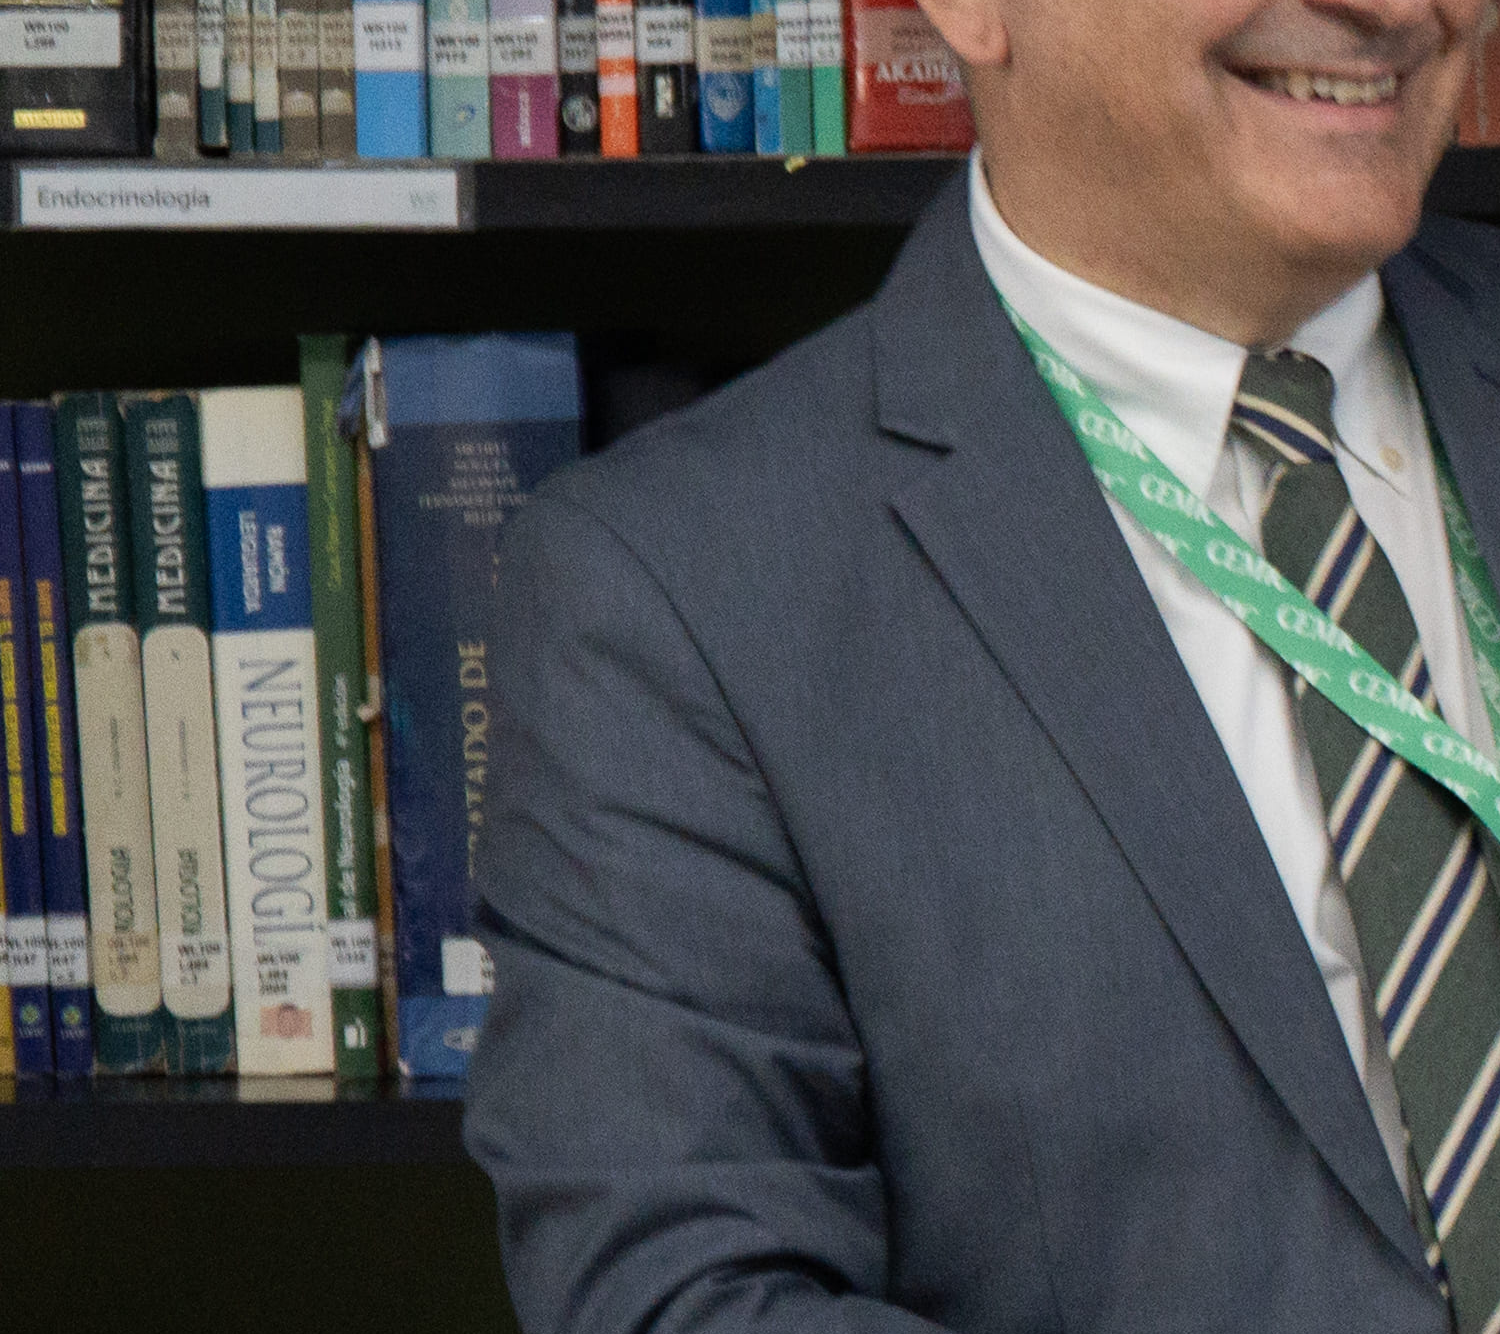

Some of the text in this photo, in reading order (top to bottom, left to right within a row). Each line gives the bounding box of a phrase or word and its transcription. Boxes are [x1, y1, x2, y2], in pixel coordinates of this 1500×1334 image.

[37, 186, 212, 213] Endocrinología
[81, 458, 119, 613] MEDICINA
[152, 458, 188, 614] MEDICINA
[236, 510, 261, 614] LEIGUARDA
[265, 523, 289, 594] RAMÓN
[237, 656, 326, 947] NEUROLOGÍ
[456, 640, 490, 880] ATADO DE
[111, 847, 133, 932] ROLOGIA
[179, 848, 201, 935] ROLOGIA
